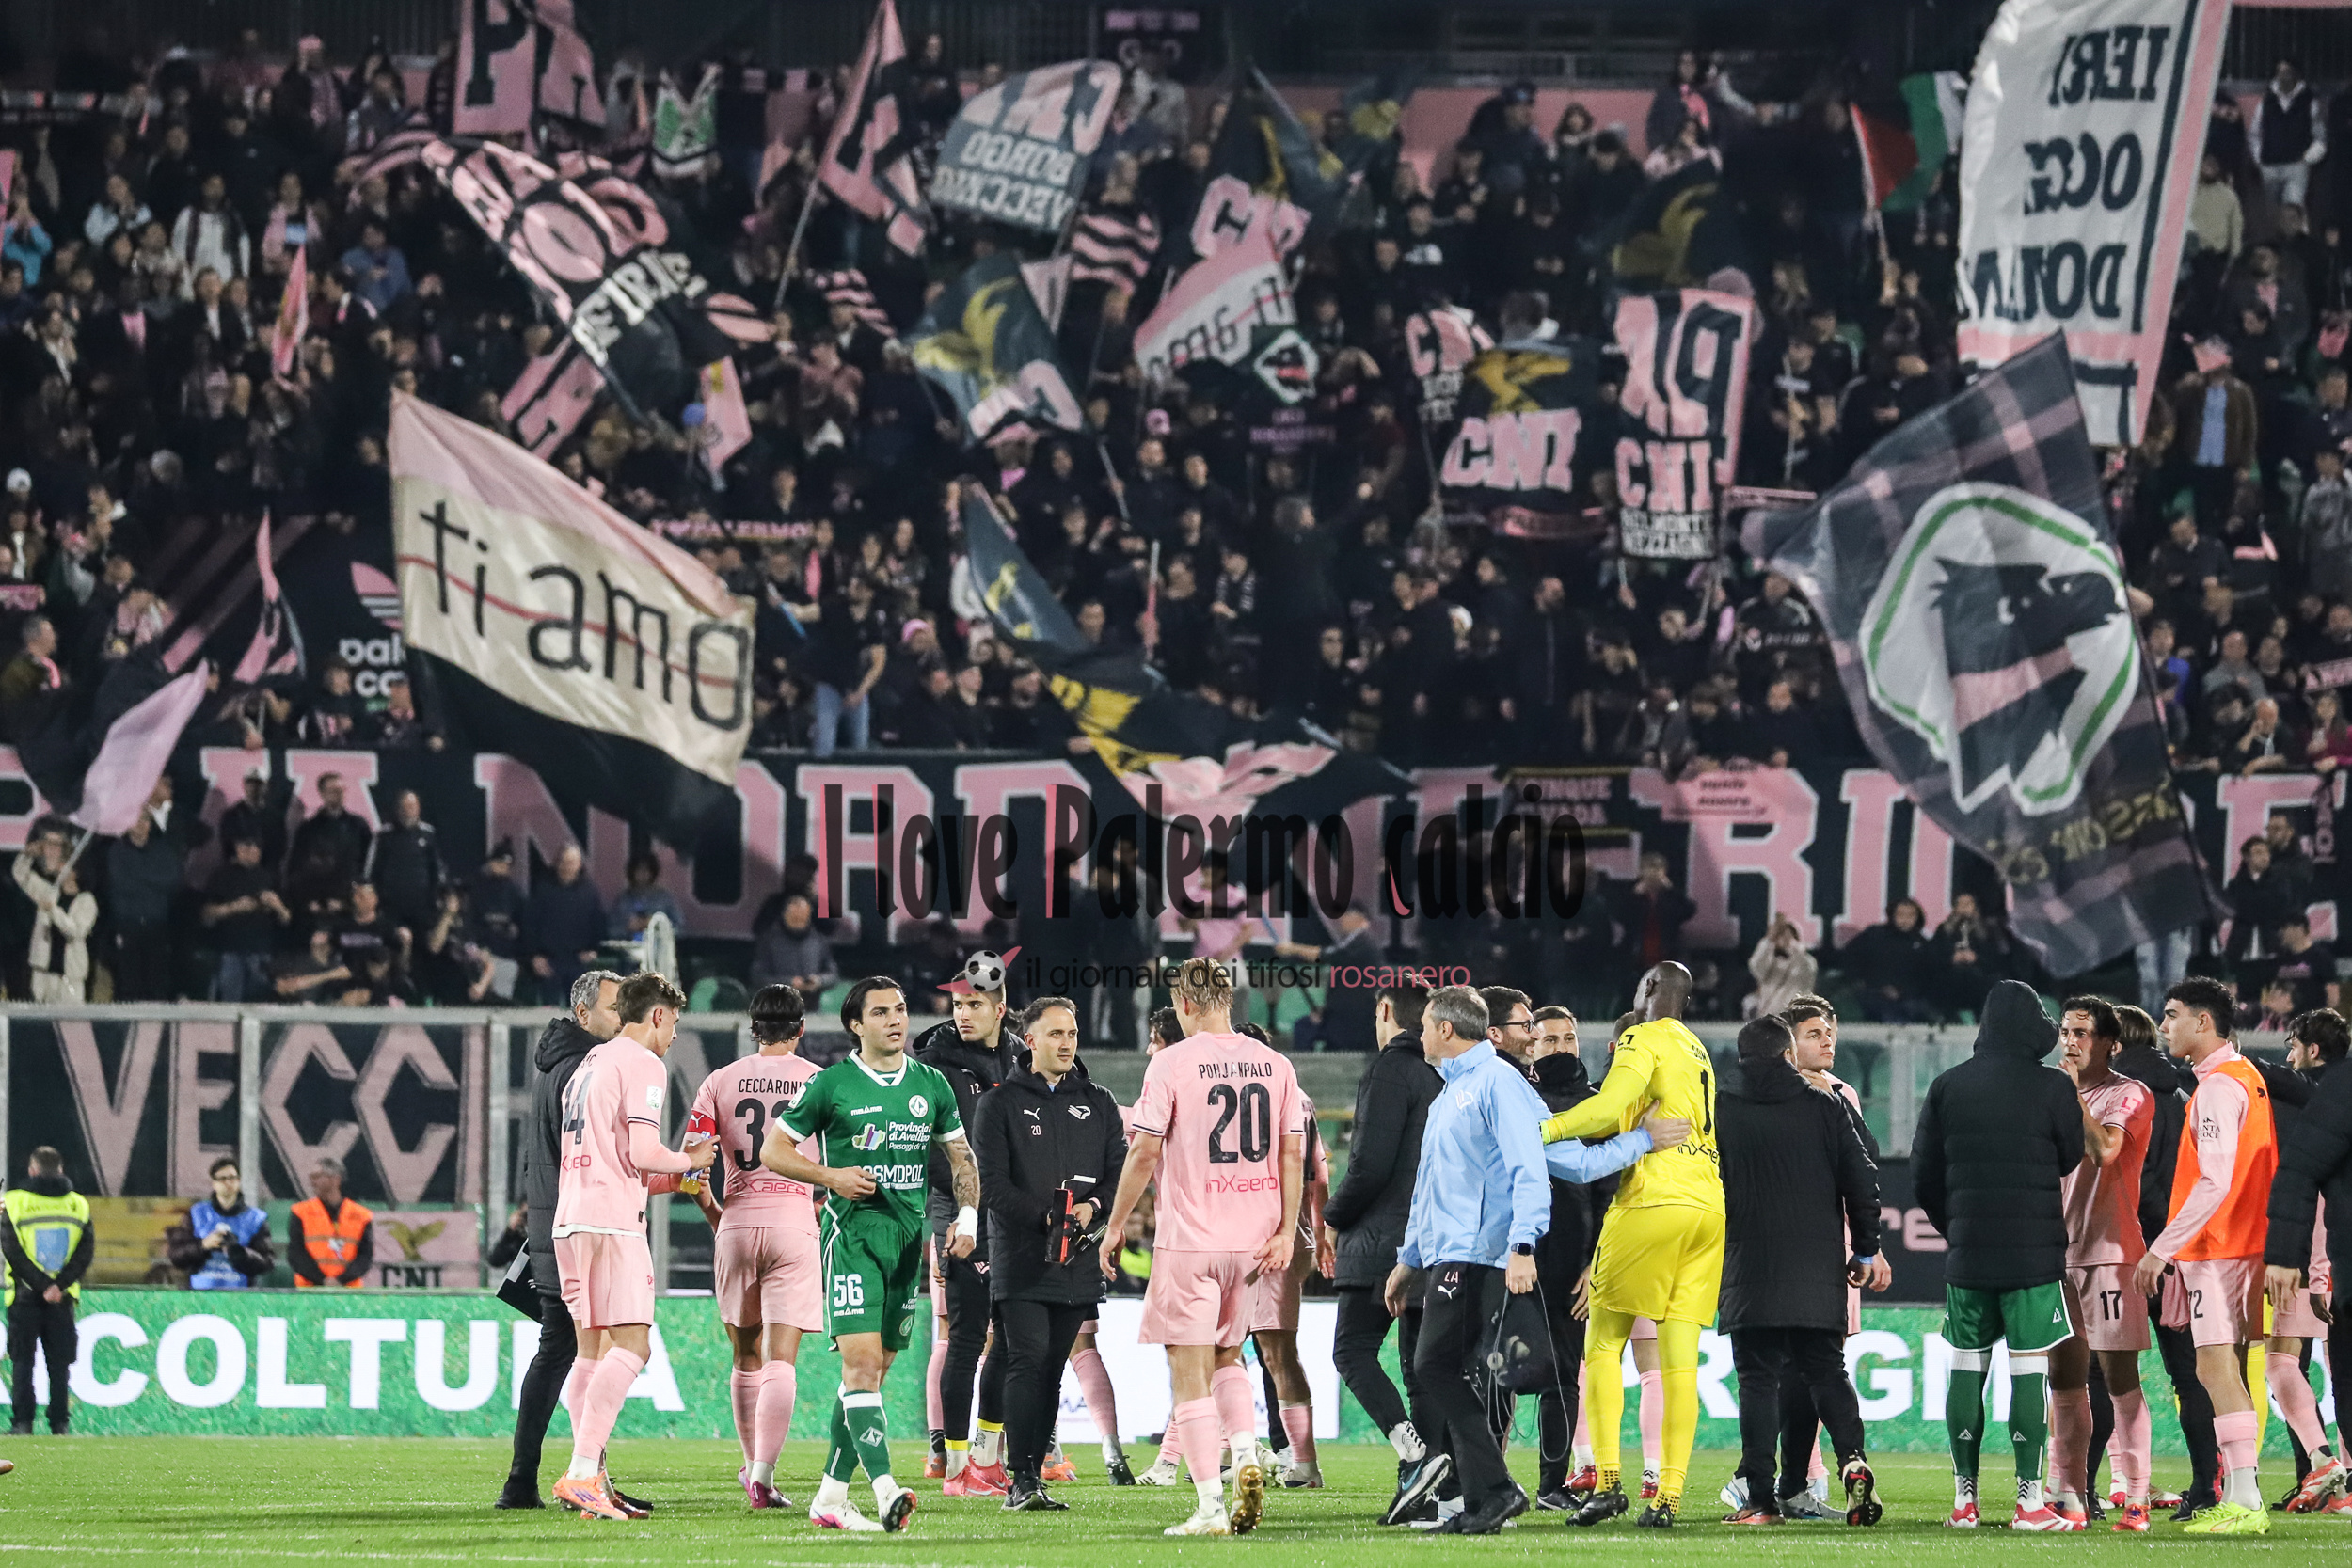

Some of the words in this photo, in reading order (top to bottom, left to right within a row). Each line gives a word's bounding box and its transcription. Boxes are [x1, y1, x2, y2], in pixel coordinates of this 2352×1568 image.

[1441, 406, 1581, 492] CNI
[1615, 436, 1712, 513] CNI
[420, 500, 487, 638] ti
[528, 565, 750, 731] amo
[969, 1083, 981, 1096] 12
[888, 1132, 898, 1141] di
[1030, 1125, 1042, 1136] 20
[1207, 1082, 1271, 1164] 20
[1205, 1175, 1278, 1194] inXaero
[834, 1274, 864, 1307] 56
[2100, 1290, 2122, 1321] 17
